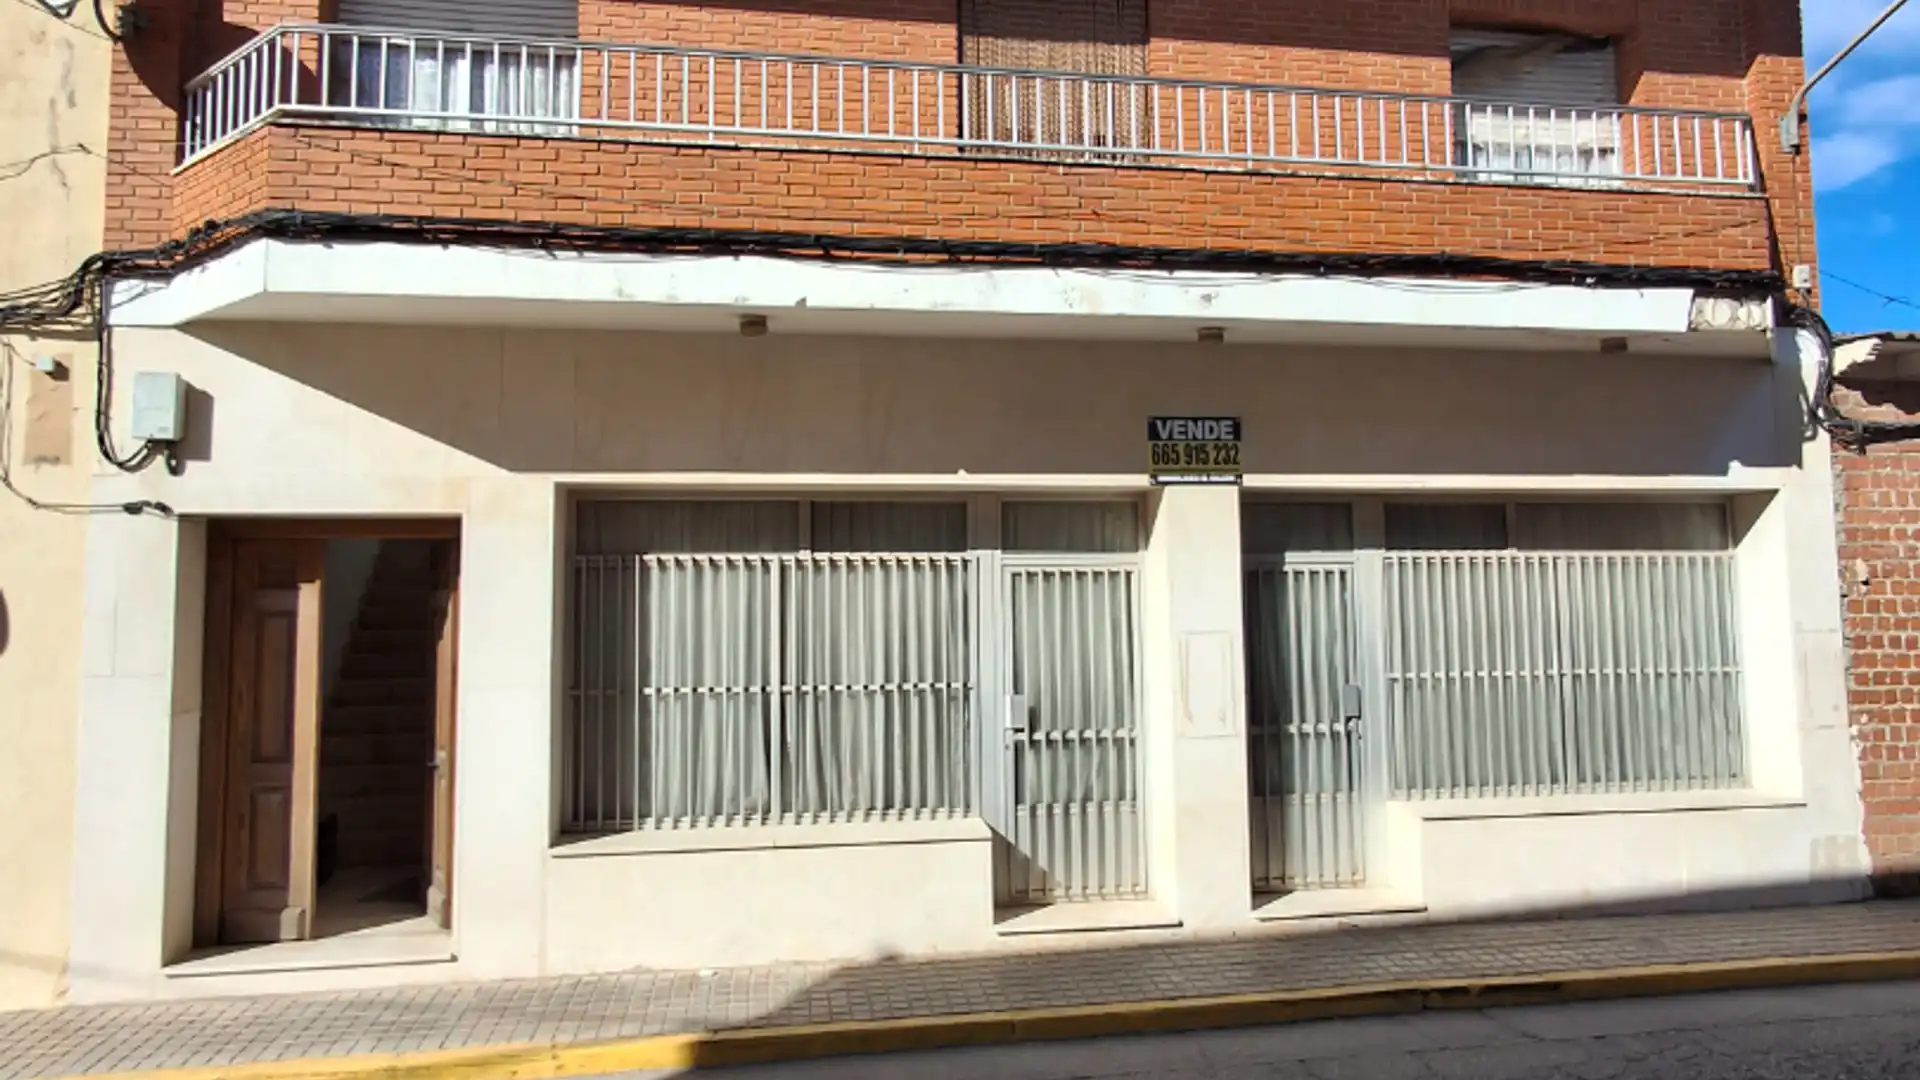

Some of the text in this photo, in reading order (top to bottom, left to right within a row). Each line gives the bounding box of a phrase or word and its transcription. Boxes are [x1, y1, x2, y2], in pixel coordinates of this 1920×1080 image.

[1156, 420, 1233, 439] VENDE
[1152, 443, 1240, 465] 665 915 232
